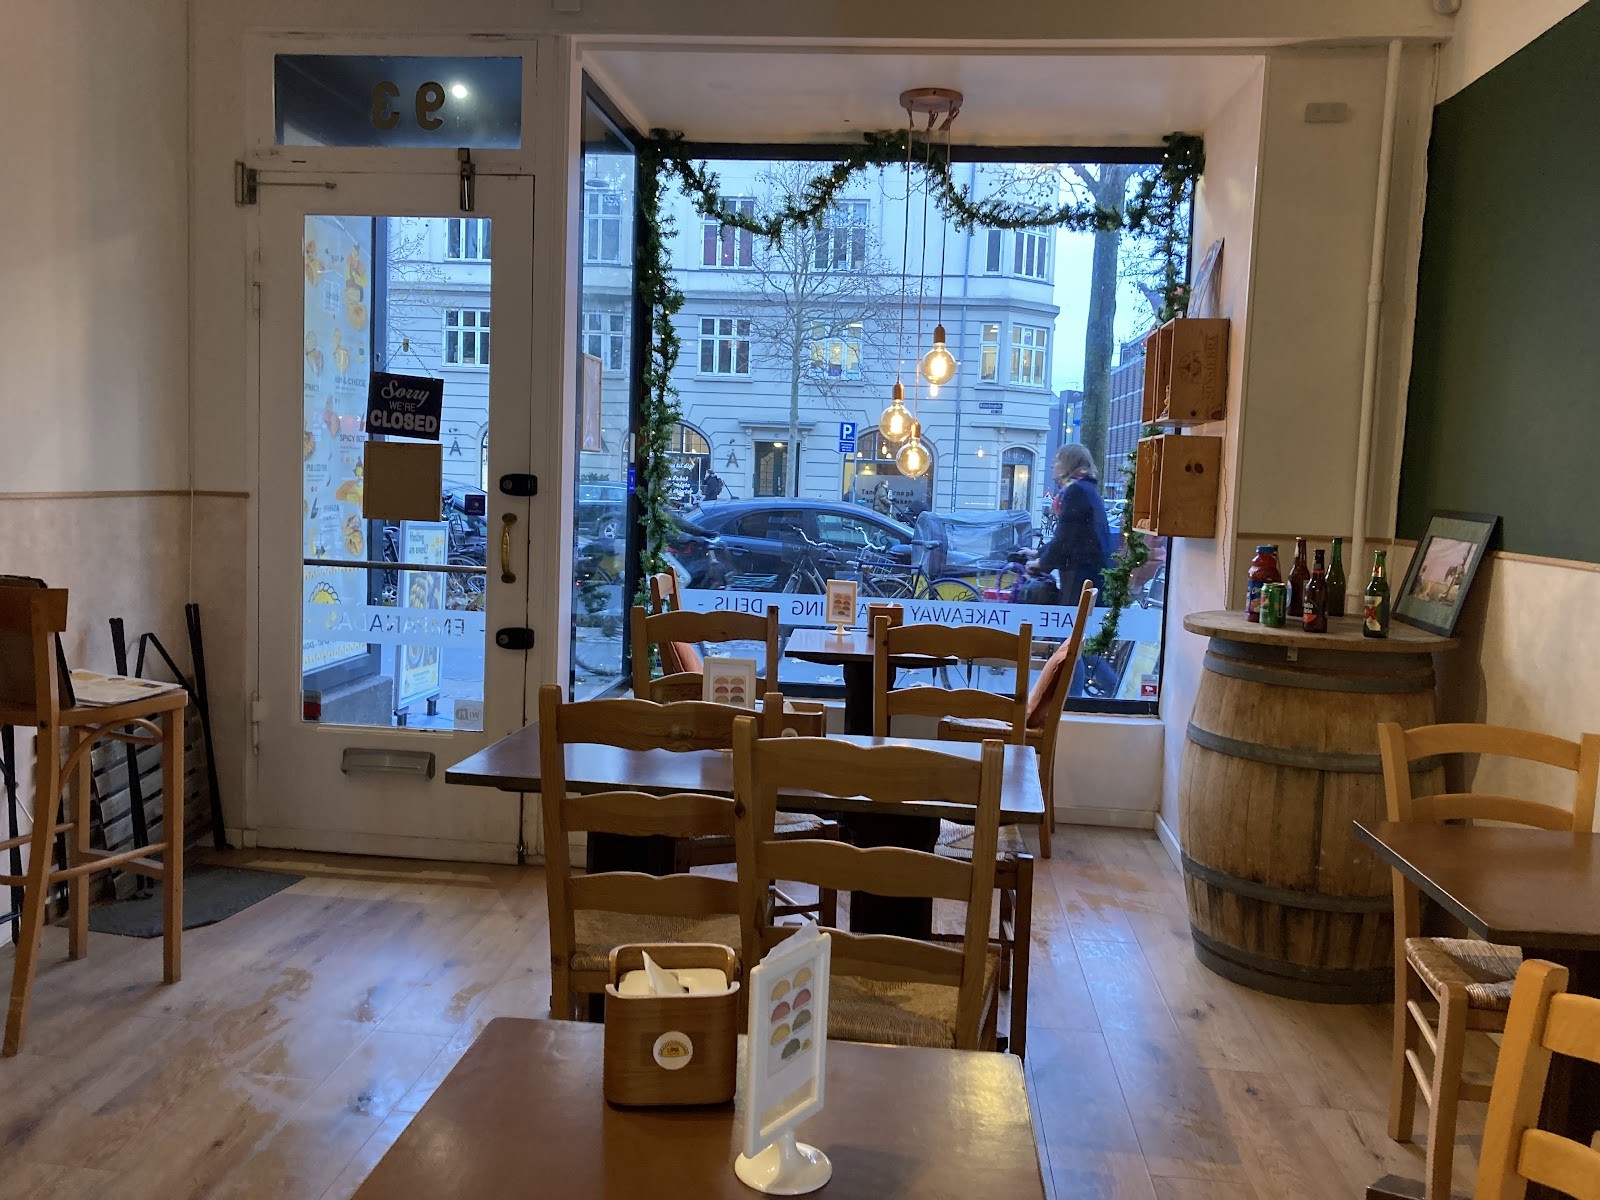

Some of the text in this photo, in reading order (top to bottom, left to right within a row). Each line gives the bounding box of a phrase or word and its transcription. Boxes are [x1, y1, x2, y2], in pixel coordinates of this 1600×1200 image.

[381, 379, 430, 408] Sorry
[389, 400, 416, 412] WE'RE
[369, 409, 438, 433] CLOSED
[843, 424, 853, 440] P
